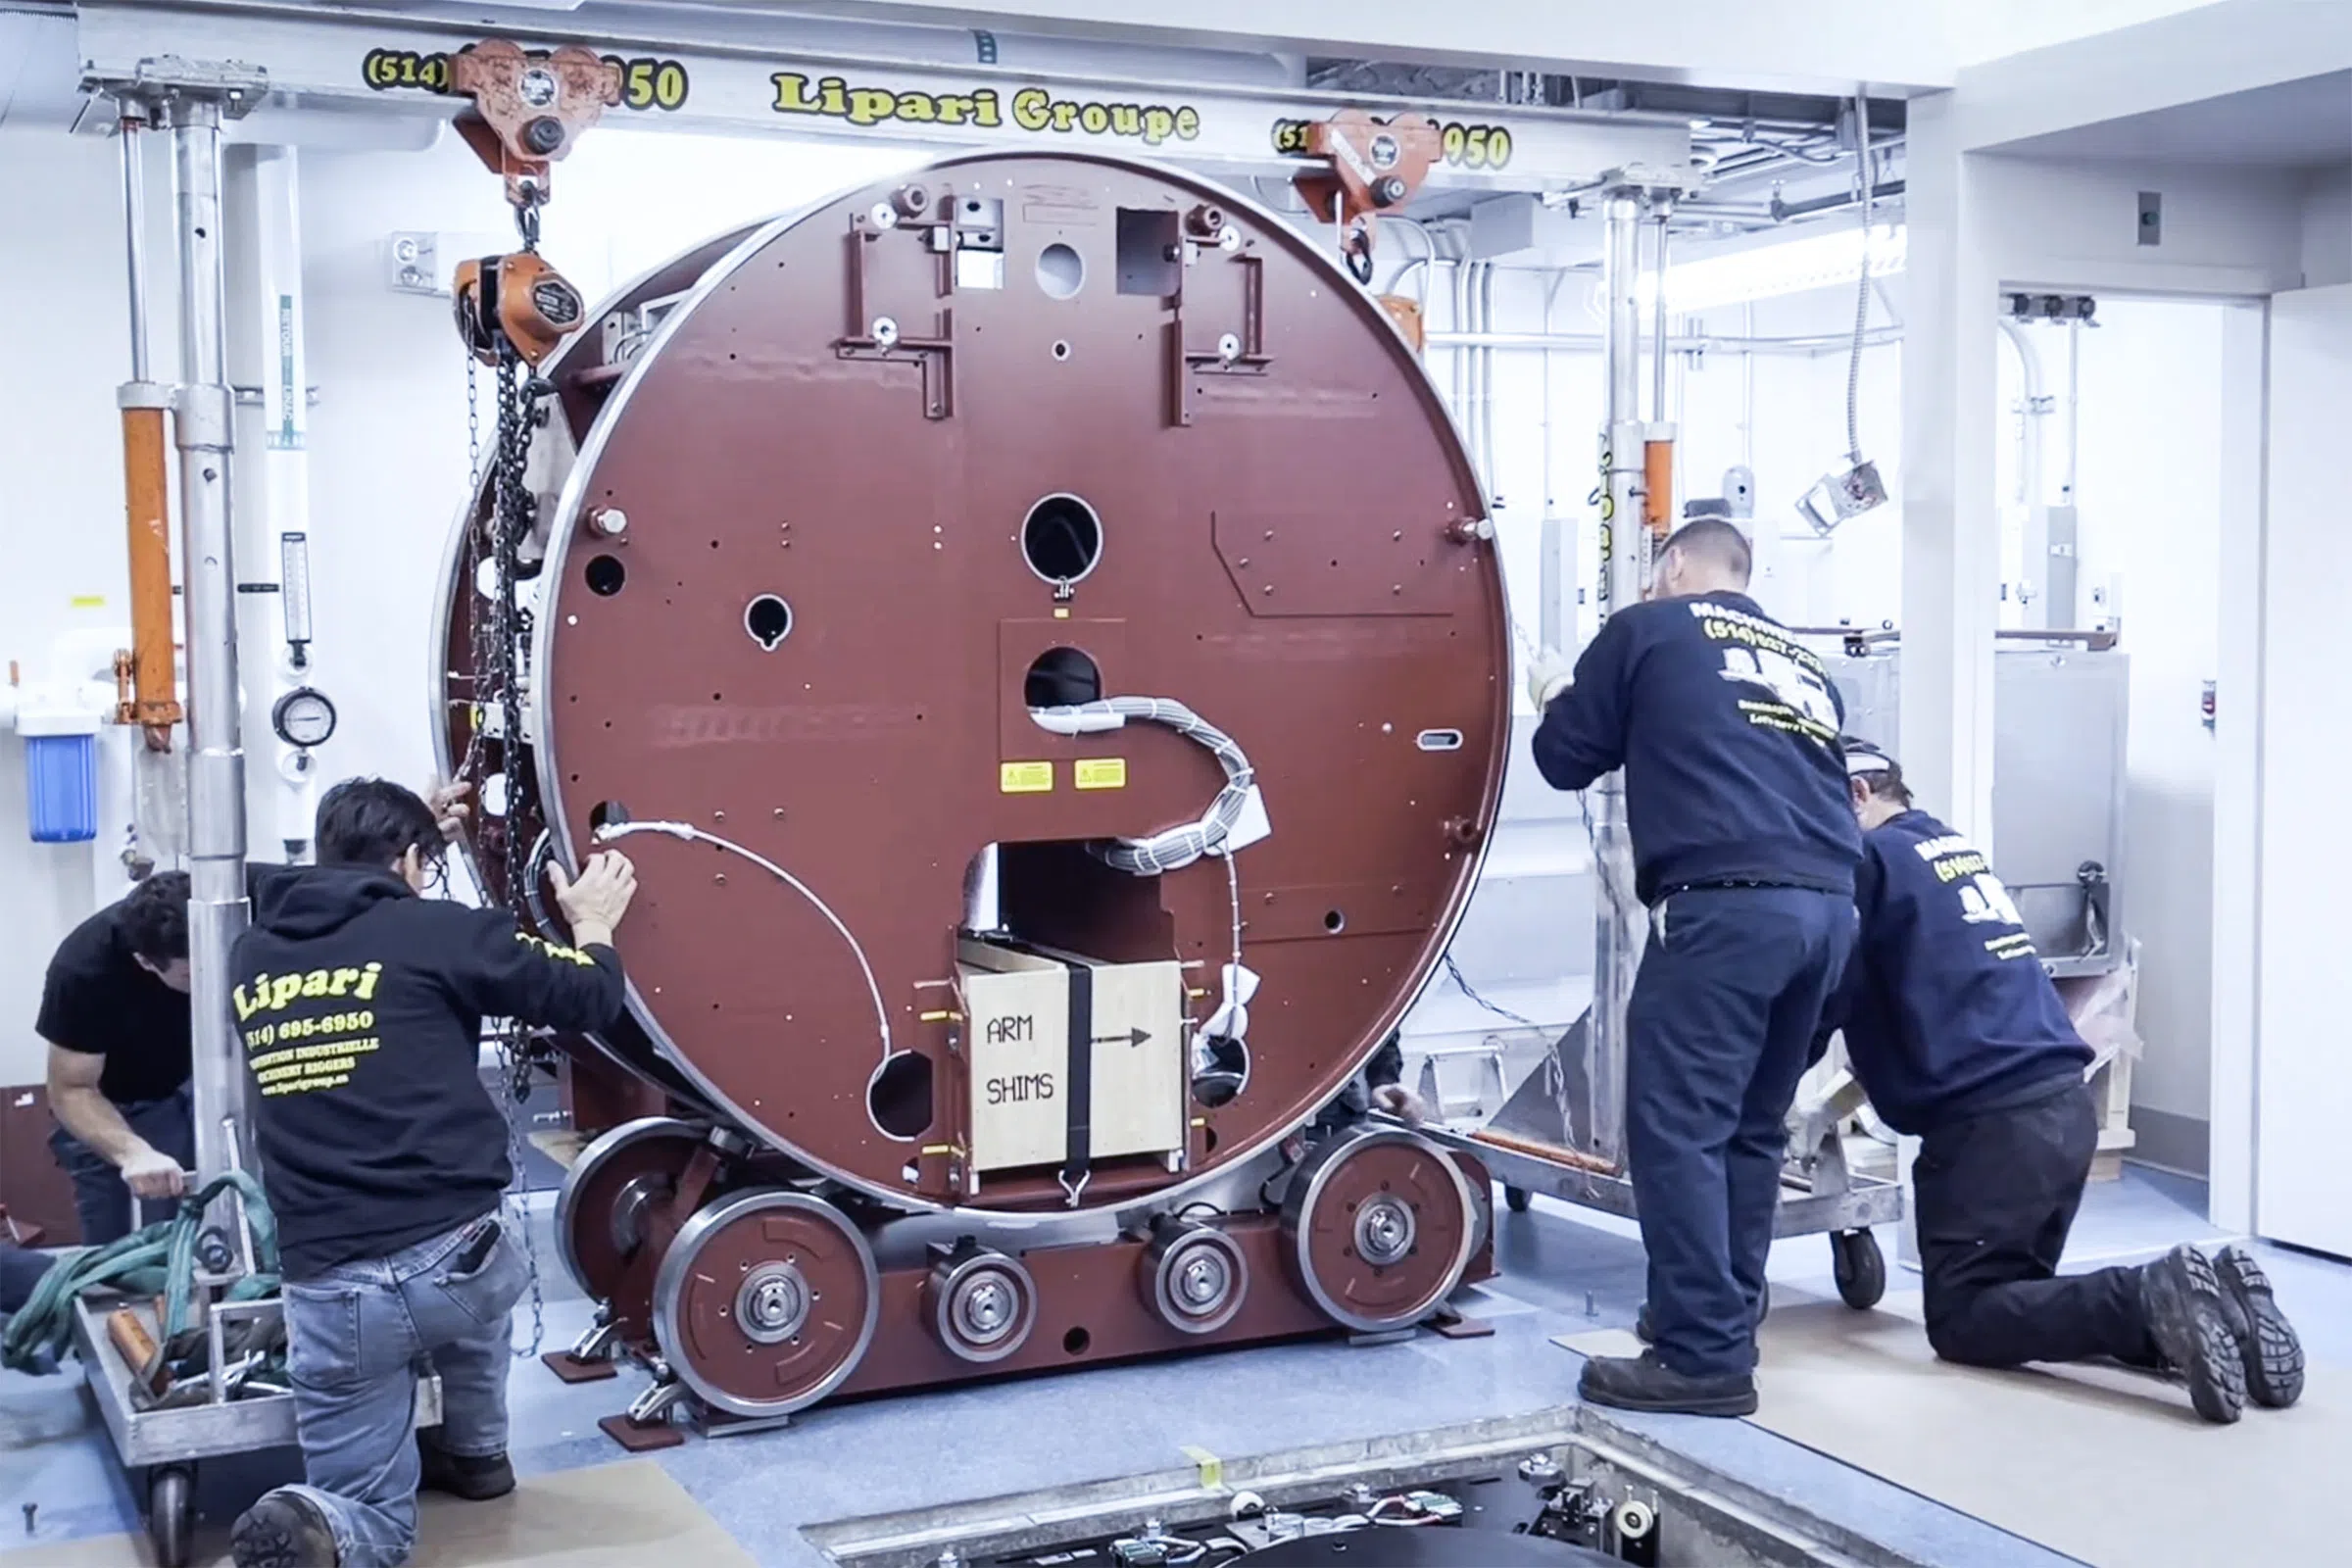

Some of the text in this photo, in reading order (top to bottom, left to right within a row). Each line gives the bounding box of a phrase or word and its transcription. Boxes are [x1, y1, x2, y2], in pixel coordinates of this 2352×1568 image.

[364, 49, 450, 94] (514)
[770, 73, 1200, 145] Lipari Groupe
[233, 961, 382, 1021] Lipari
[278, 1010, 373, 1040] 695-6950
[987, 1014, 1032, 1044] ARM
[987, 1073, 1054, 1104] SHIMS
